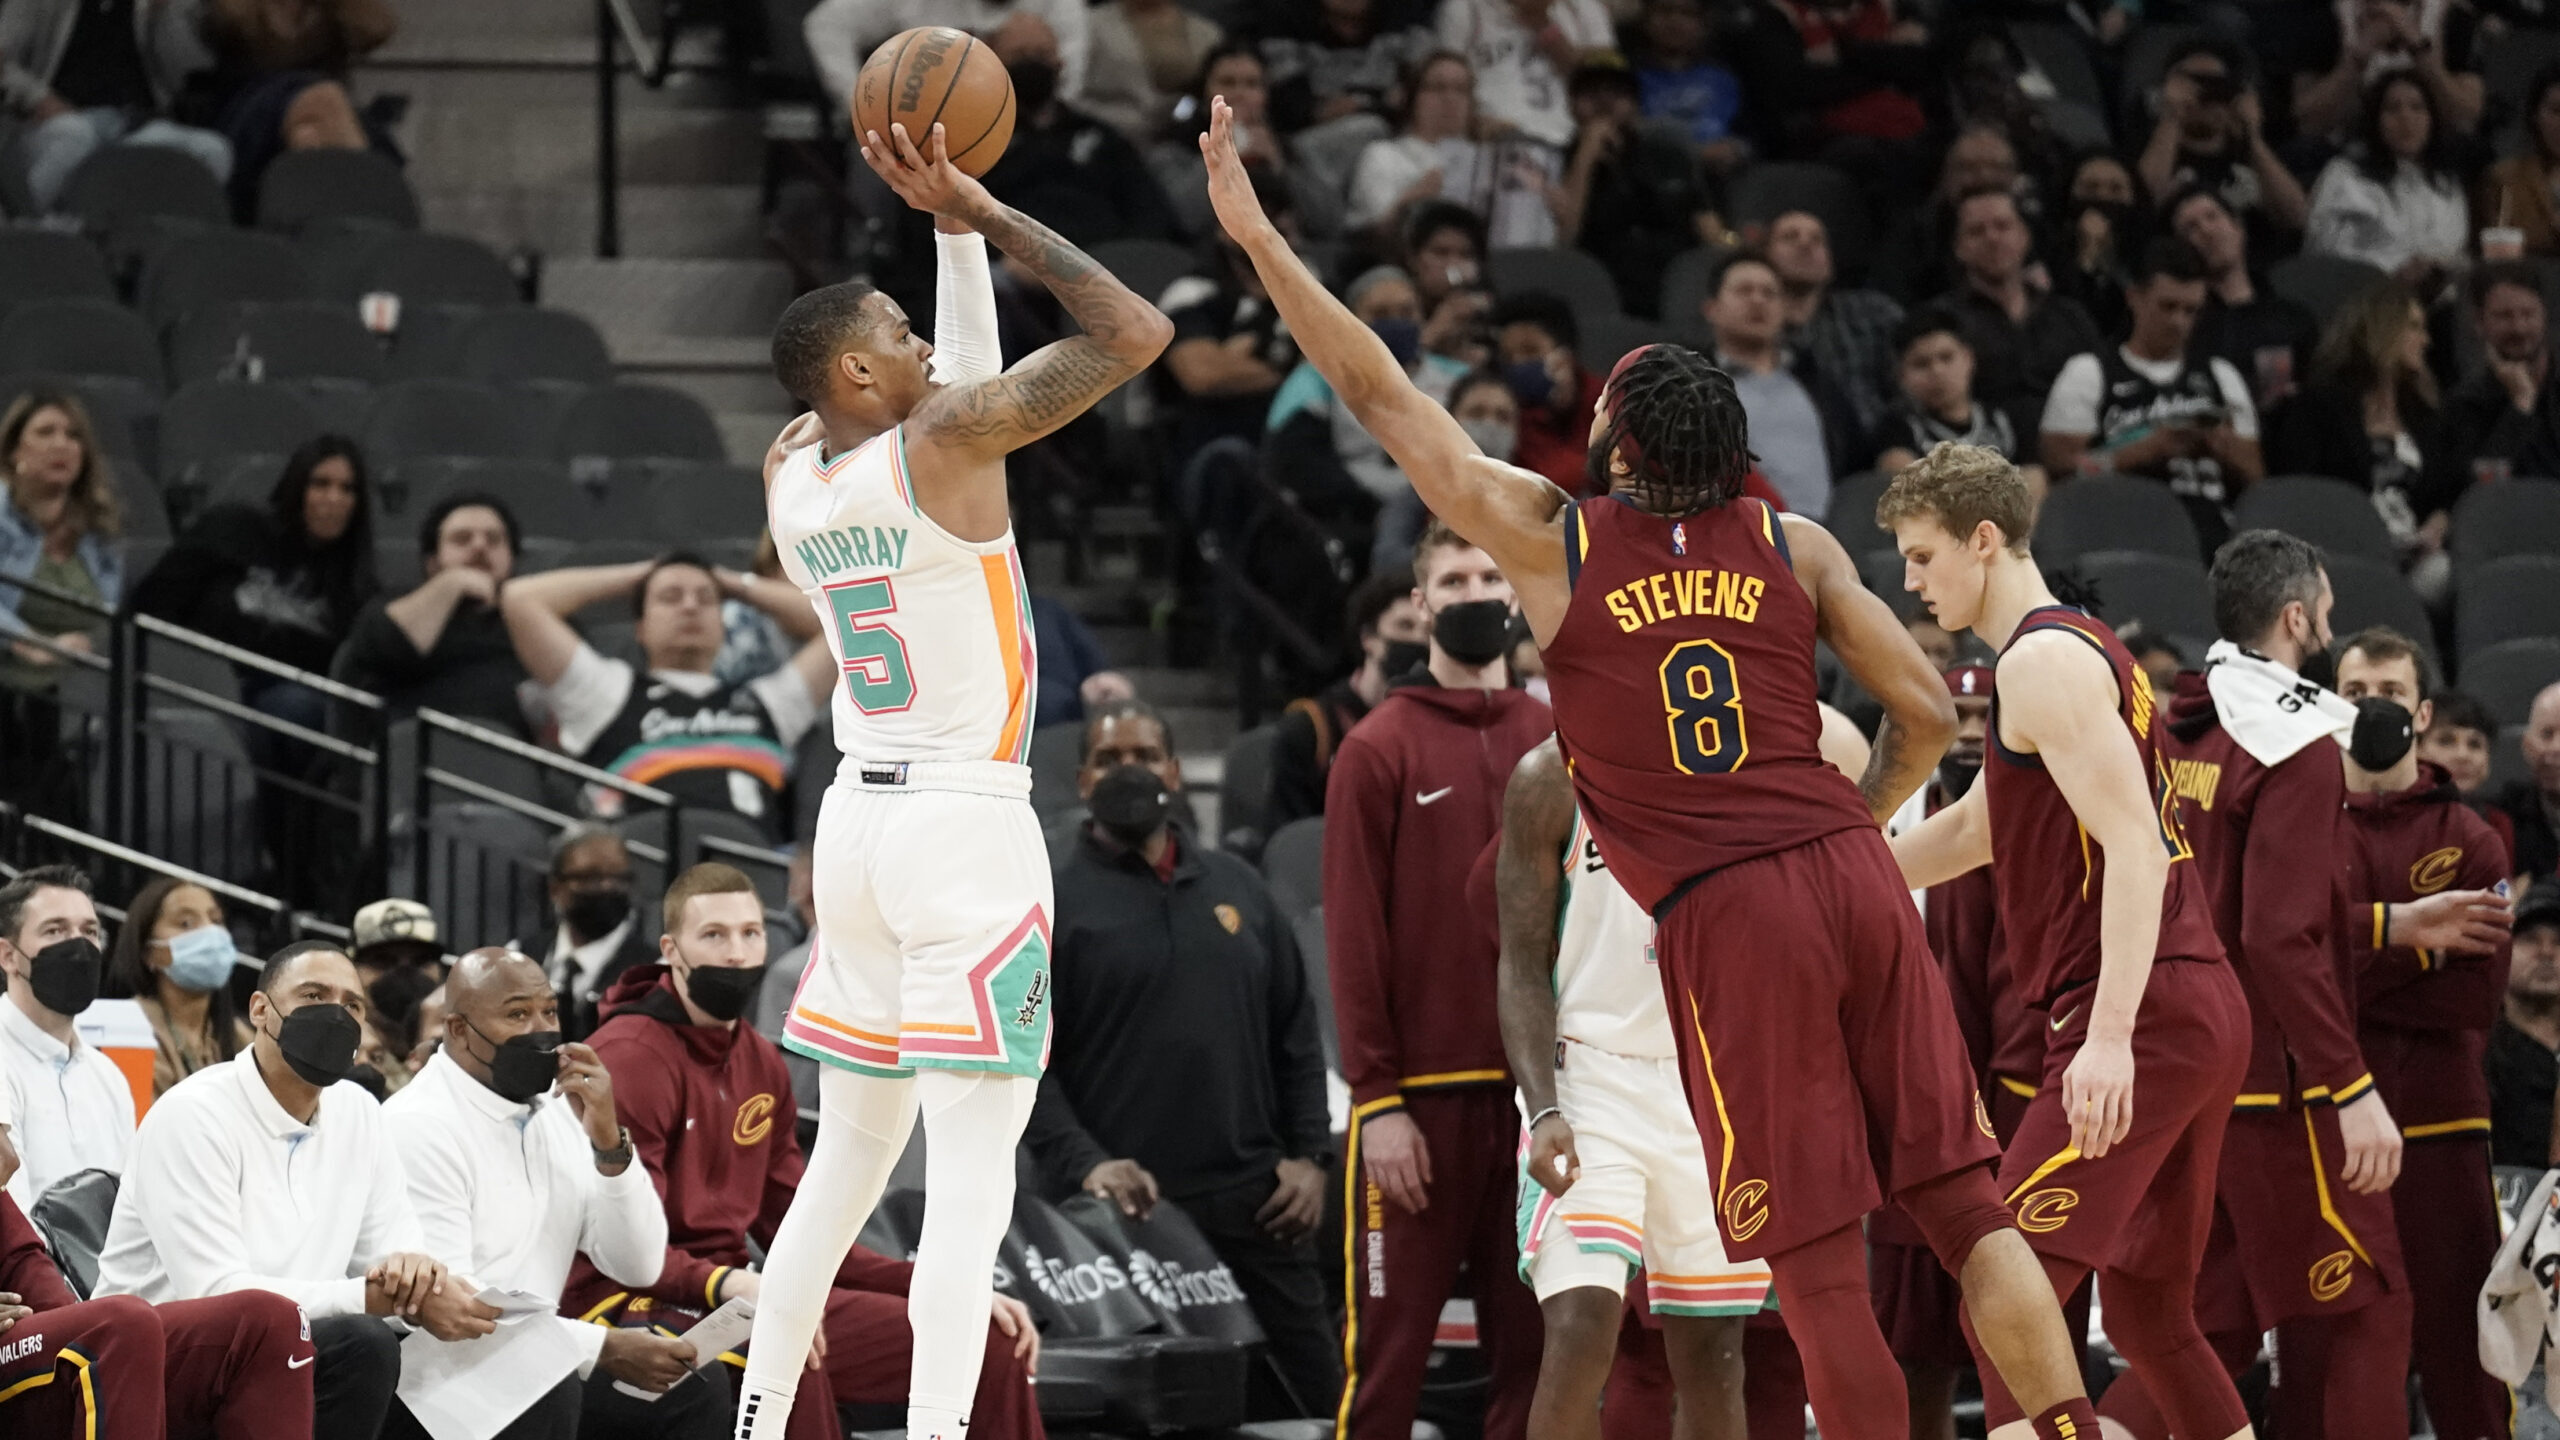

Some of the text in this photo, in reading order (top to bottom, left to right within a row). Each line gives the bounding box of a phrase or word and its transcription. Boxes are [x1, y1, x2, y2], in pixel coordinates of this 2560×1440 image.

[795, 526, 908, 584] MURRAY
[1605, 569, 1765, 633] STEVENS
[822, 575, 918, 716] 5
[1658, 638, 1749, 776] 8
[1044, 1255, 1128, 1305] Fros
